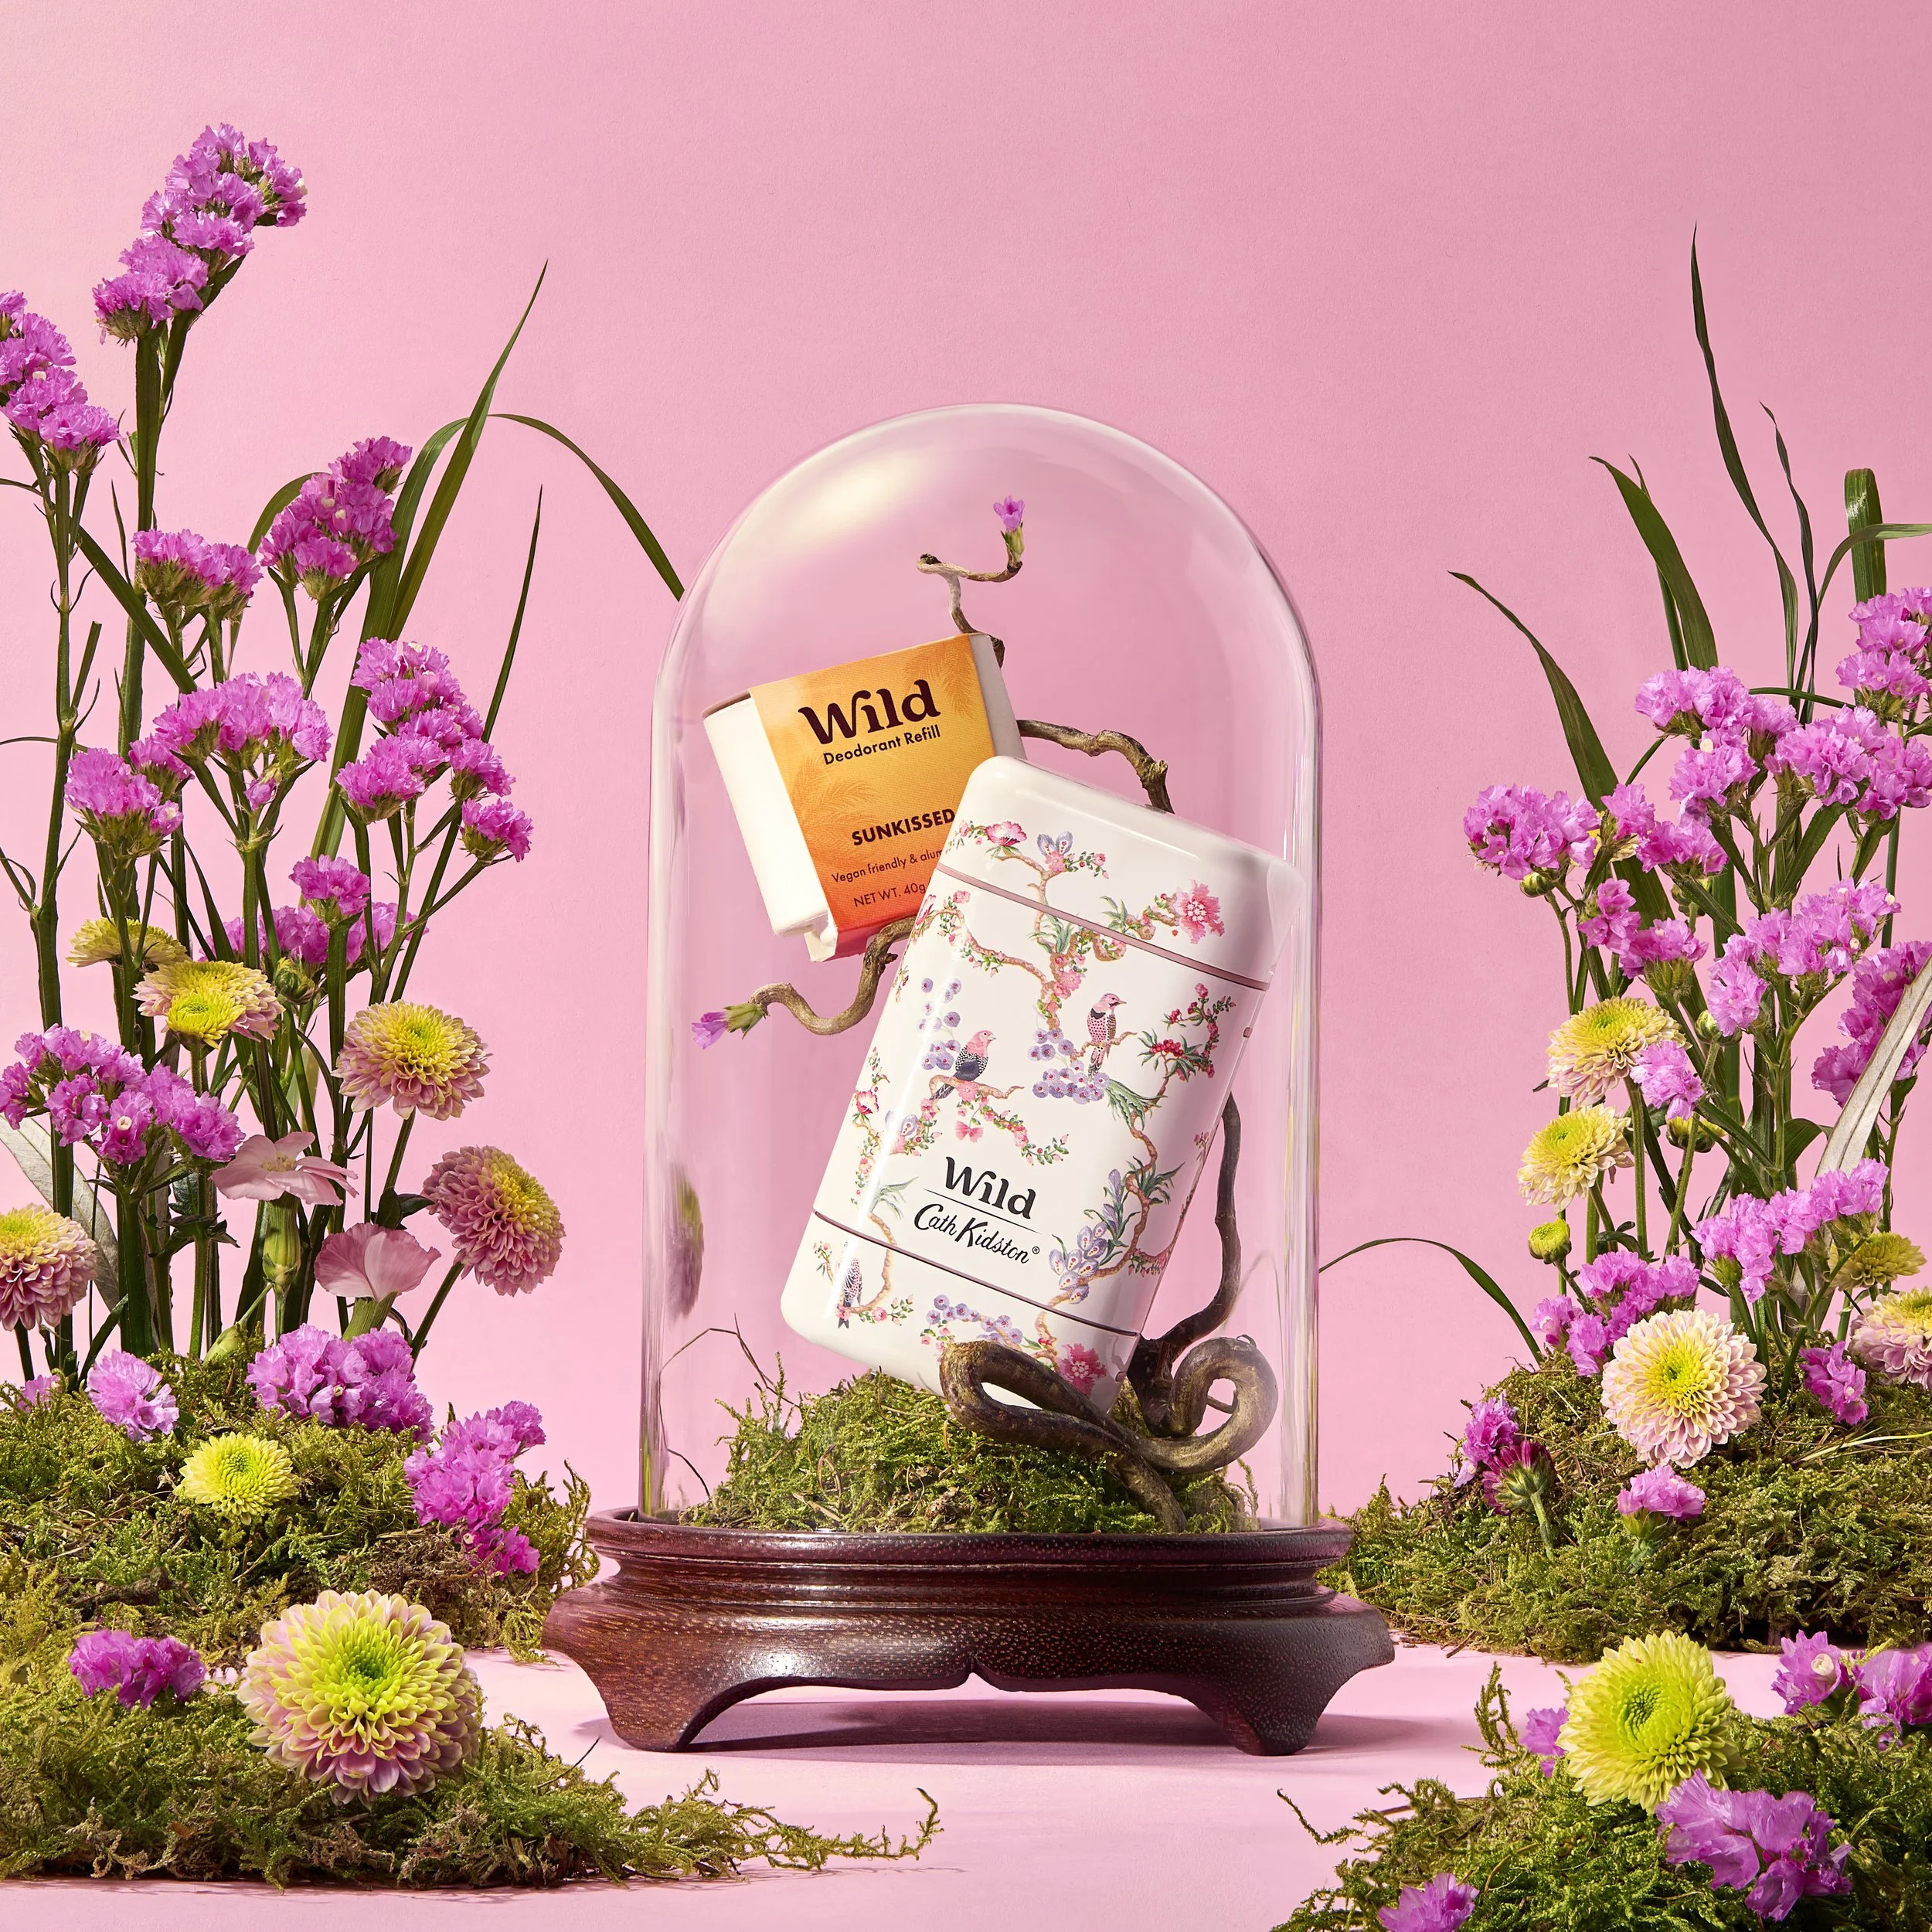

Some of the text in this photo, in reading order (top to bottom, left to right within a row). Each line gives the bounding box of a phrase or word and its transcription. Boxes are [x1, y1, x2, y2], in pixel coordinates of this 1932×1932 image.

[798, 679, 941, 744] Wild
[823, 724, 940, 765] Deodorant Refill
[852, 808, 955, 845] SUNKISSED
[832, 869, 866, 883] Vegan
[868, 857, 906, 874] friendly
[910, 854, 917, 863] &
[854, 883, 926, 907] NET WT. 40g
[945, 1156, 1036, 1219] Wild
[914, 1203, 957, 1236] Cath
